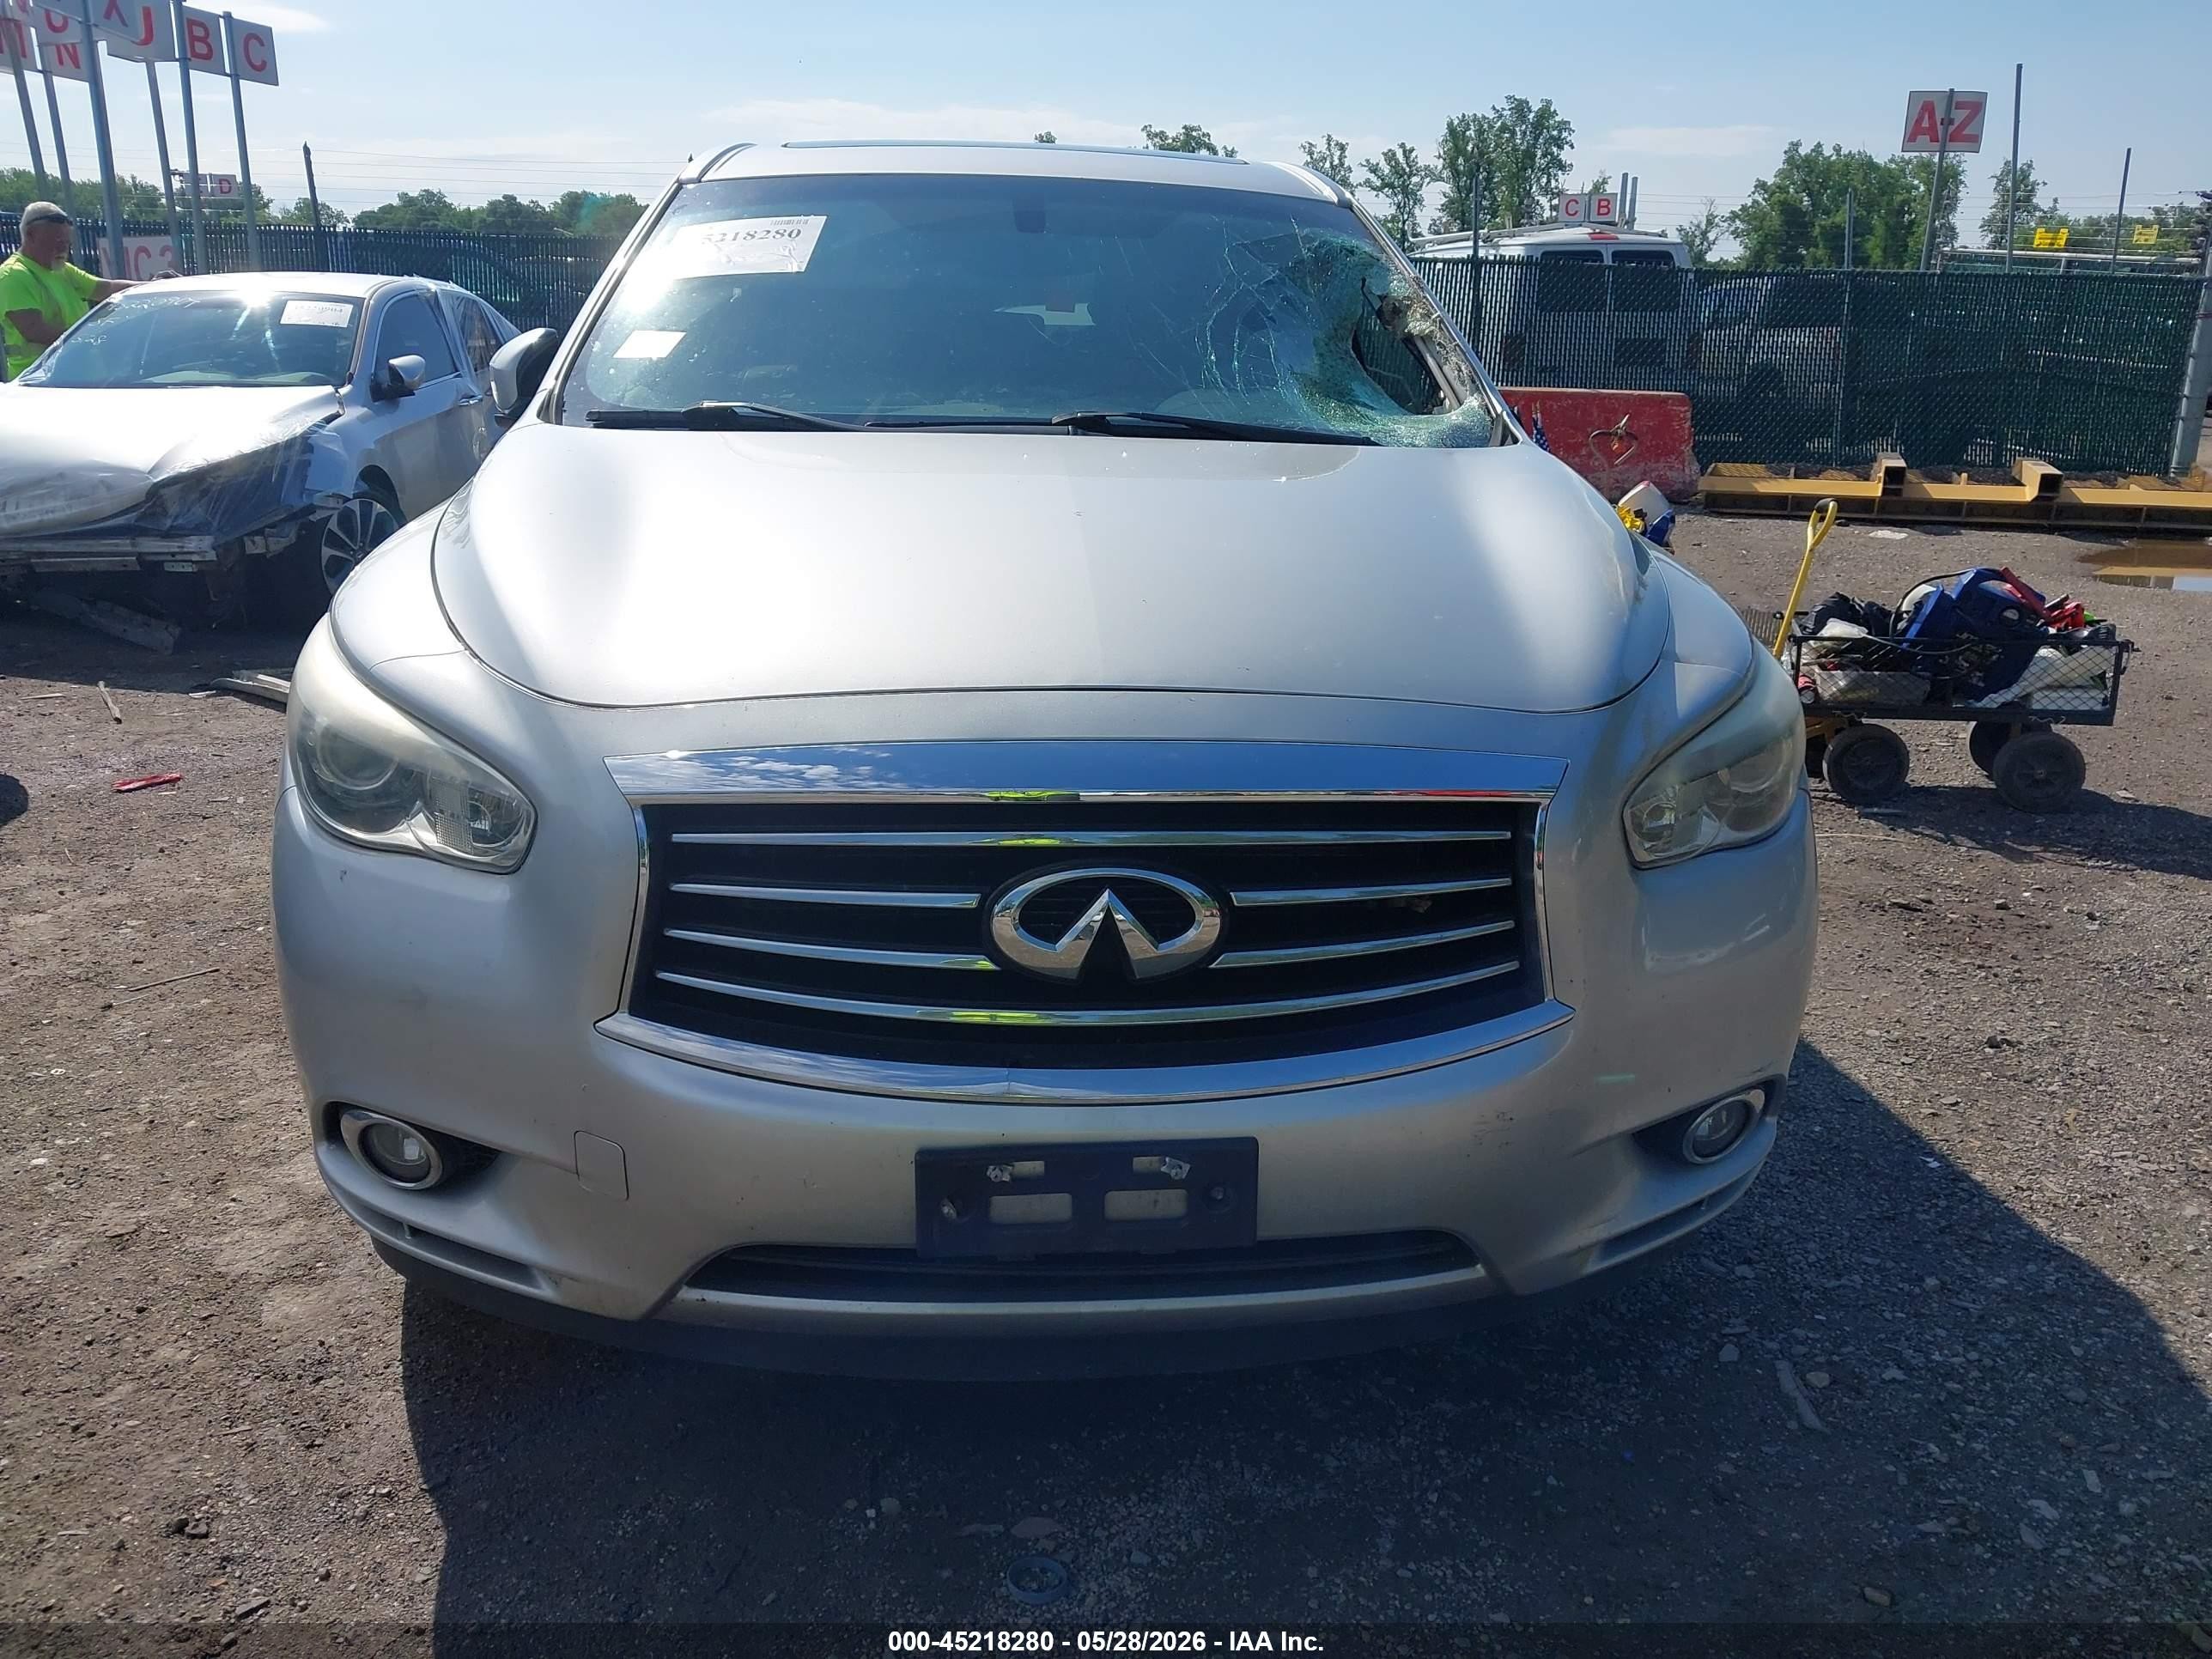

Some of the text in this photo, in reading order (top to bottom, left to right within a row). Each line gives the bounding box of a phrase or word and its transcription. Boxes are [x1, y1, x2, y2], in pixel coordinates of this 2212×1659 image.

[186, 17, 215, 60] B
[243, 33, 268, 73] C
[1906, 100, 1984, 143] A-Z
[219, 178, 232, 194] D
[1565, 198, 1579, 216] C
[1596, 198, 1611, 216] B
